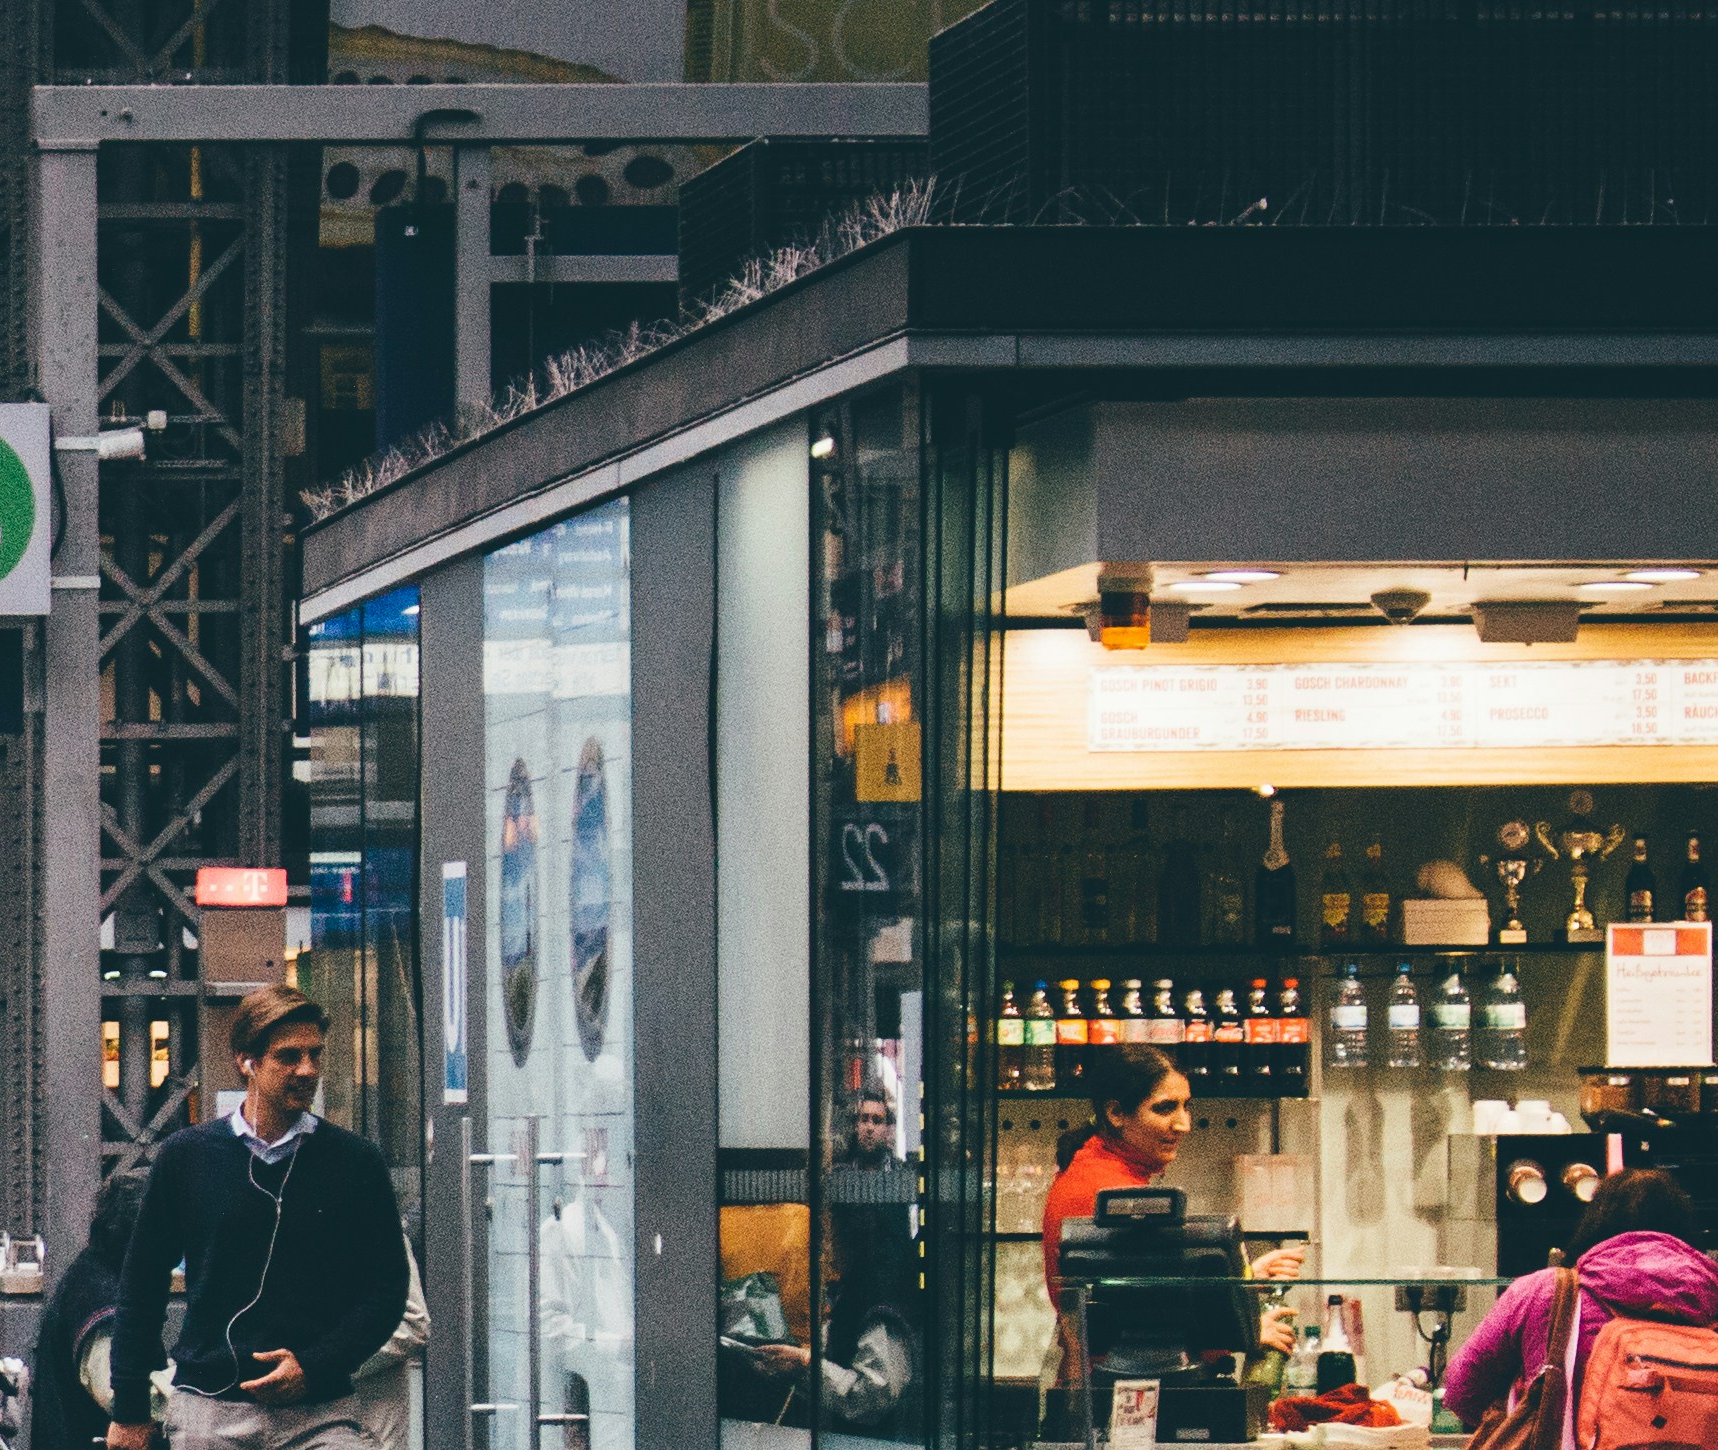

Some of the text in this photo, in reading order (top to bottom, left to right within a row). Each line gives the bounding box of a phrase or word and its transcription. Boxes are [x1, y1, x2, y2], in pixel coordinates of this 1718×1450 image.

[1142, 679, 1174, 691] PINOT
[1178, 678, 1216, 691] GRIGIO
[1335, 676, 1409, 689] CHARDONNAY
[1294, 708, 1347, 722] RIESLING
[1490, 707, 1549, 721] PROSECCO
